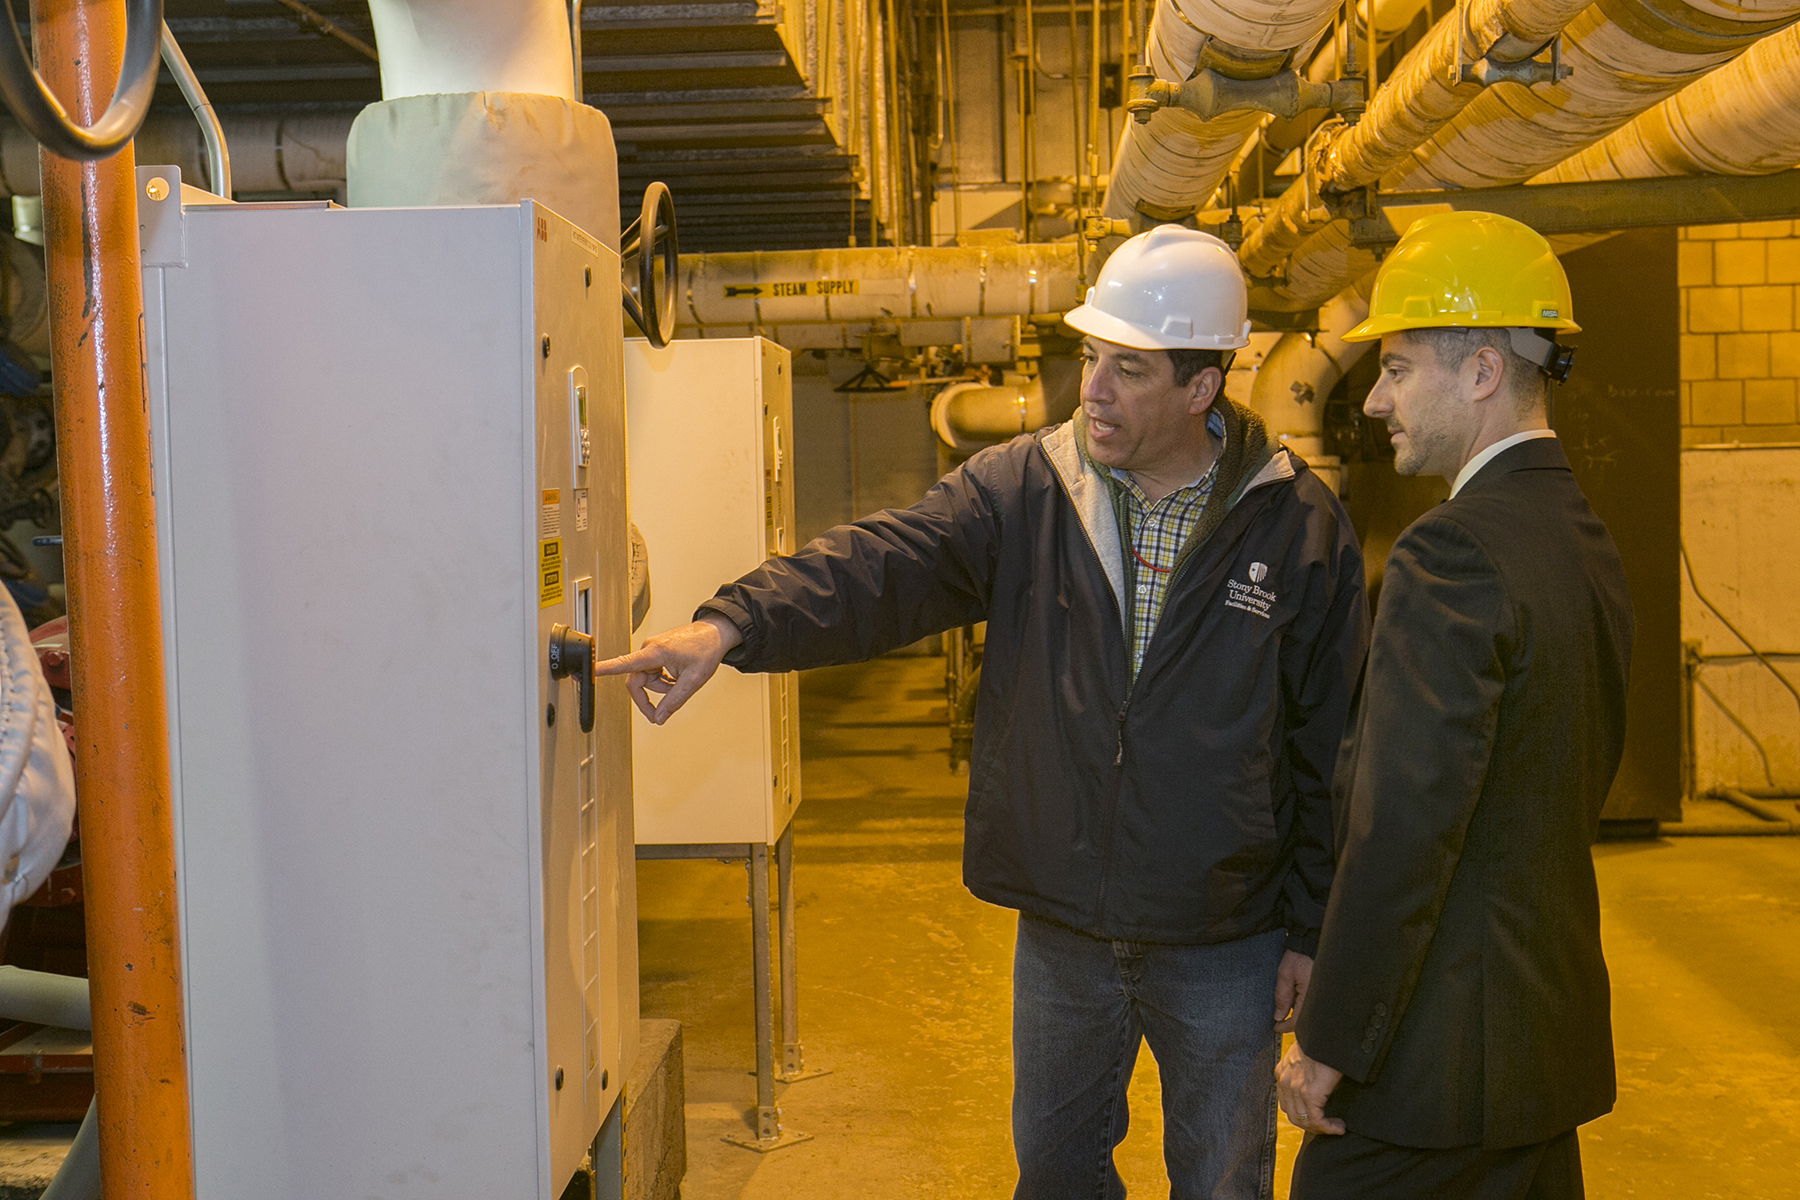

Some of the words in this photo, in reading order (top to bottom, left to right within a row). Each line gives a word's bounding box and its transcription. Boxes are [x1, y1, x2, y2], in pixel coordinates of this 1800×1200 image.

[773, 283, 807, 296] STEAM
[817, 281, 853, 294] SUPPLY
[1227, 579, 1252, 593] Stony
[1252, 585, 1276, 602] Brook
[1229, 590, 1271, 611] University
[550, 643, 560, 660] OFF
